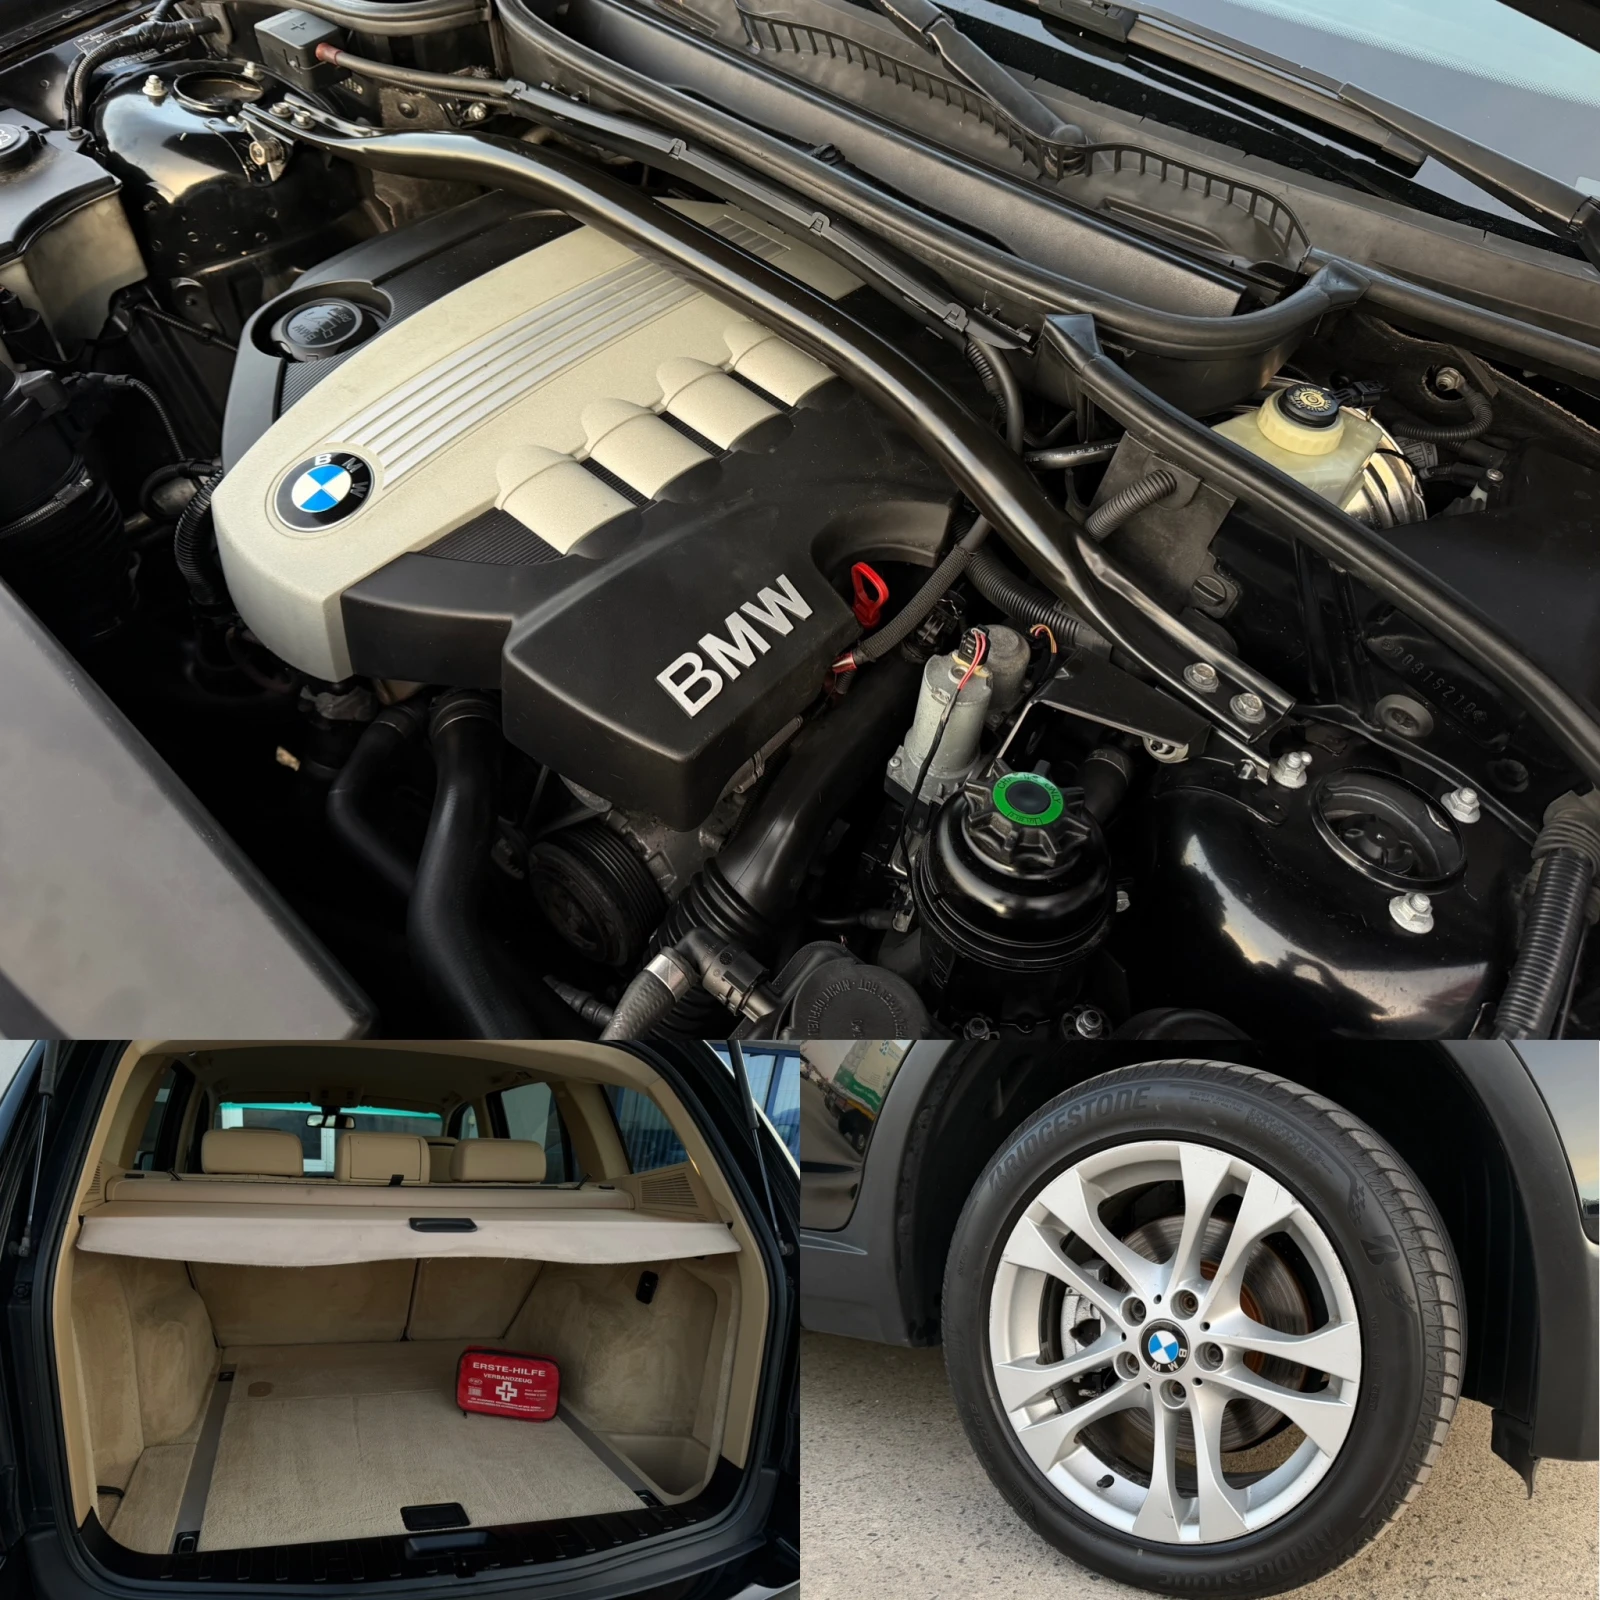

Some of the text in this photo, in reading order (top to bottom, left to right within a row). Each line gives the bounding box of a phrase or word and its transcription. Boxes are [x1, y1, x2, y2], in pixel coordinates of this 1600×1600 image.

[314, 453, 369, 499] BMW
[655, 573, 814, 719] BMW
[988, 1086, 1152, 1194] BRIDGESTONE
[472, 1361, 546, 1377] ERSTE-HILFE
[1151, 1347, 1188, 1372] BMW
[483, 1372, 533, 1384] VERBANDZEUG
